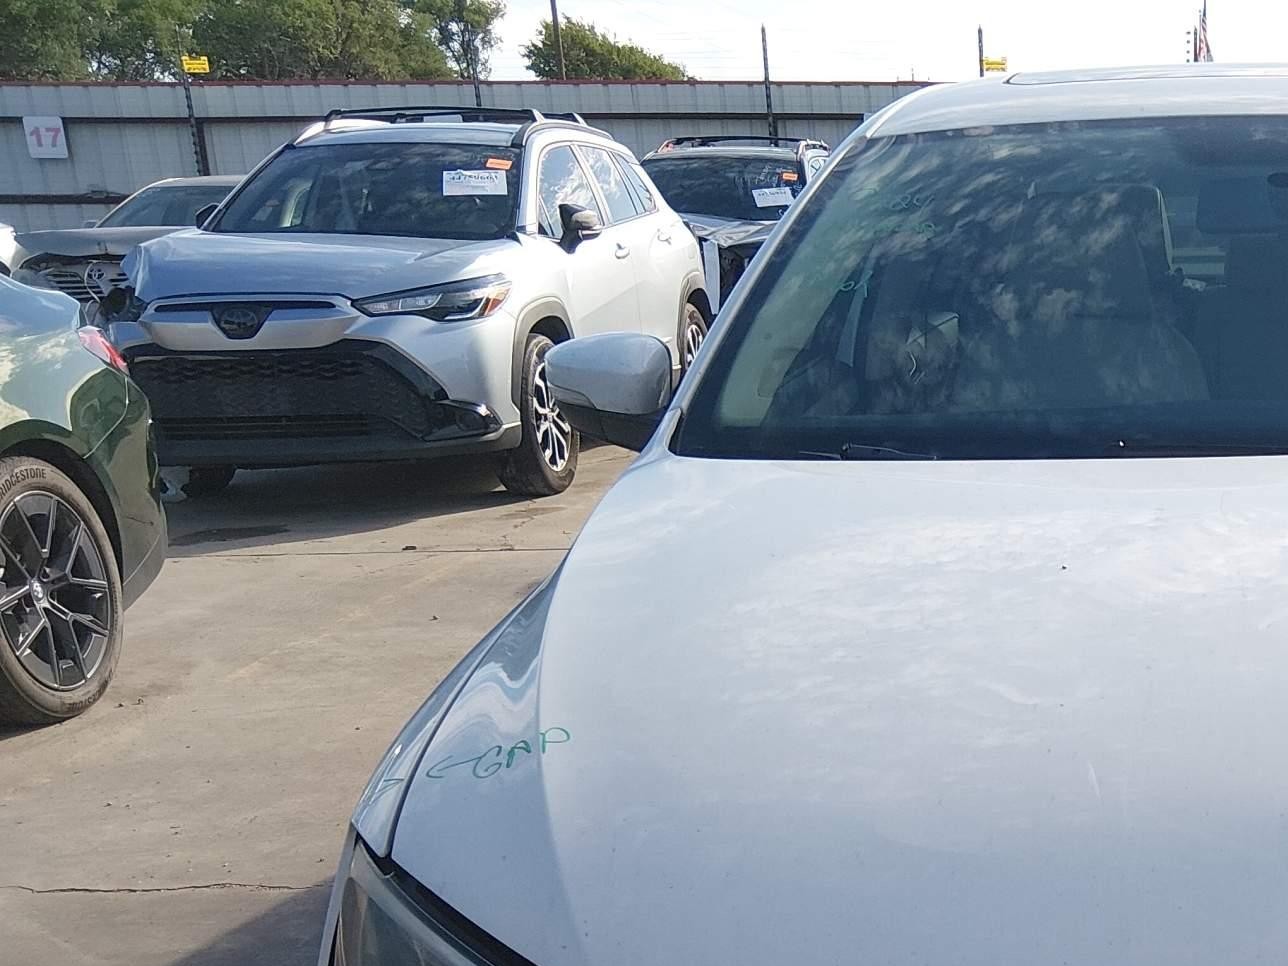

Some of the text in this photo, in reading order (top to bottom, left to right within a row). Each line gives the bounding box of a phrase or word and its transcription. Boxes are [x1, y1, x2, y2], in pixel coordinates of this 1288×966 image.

[30, 126, 61, 148] 17
[0, 467, 47, 499] RIDGESTONE
[472, 727, 571, 779] GAP
